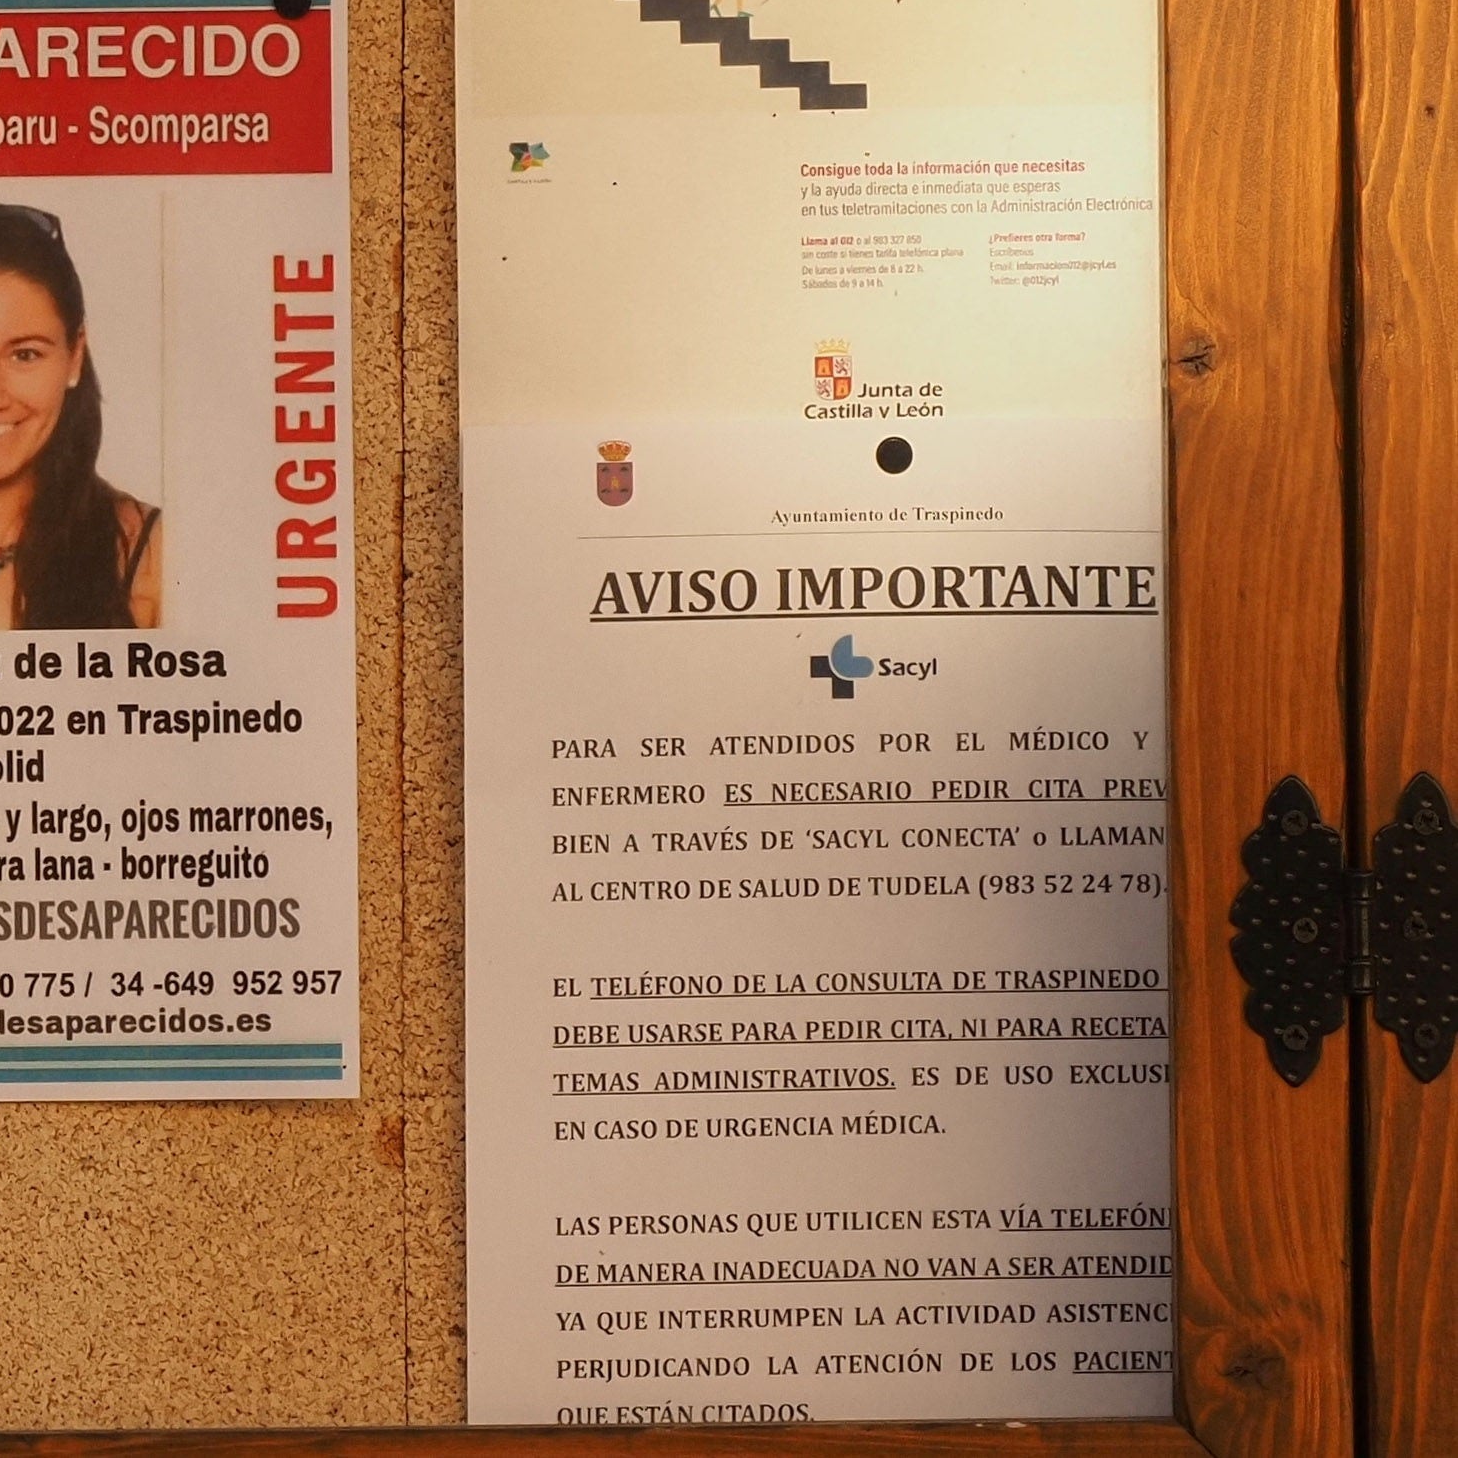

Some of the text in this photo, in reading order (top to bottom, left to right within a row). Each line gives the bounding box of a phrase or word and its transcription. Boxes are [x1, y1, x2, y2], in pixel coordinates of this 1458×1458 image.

[90, 109, 268, 152] Scomparsa
[800, 163, 861, 179] Consigue
[864, 162, 893, 176] toda
[912, 160, 990, 174] información
[1022, 159, 1085, 173] necesitas
[858, 382, 942, 398] Junta de
[273, 253, 339, 617] URGENTE
[775, 508, 883, 527] Ayuntamiento
[912, 507, 1003, 524] Traspinedo
[590, 566, 1155, 614] AVISO IMPORTANTE
[14, 643, 62, 679] de
[78, 643, 113, 678] la
[128, 643, 227, 677] Rosa
[67, 710, 105, 735] en
[117, 702, 302, 738] Traspinedo
[555, 1112, 945, 1140] EN CASO DE URGENCIA MÉDICA.
